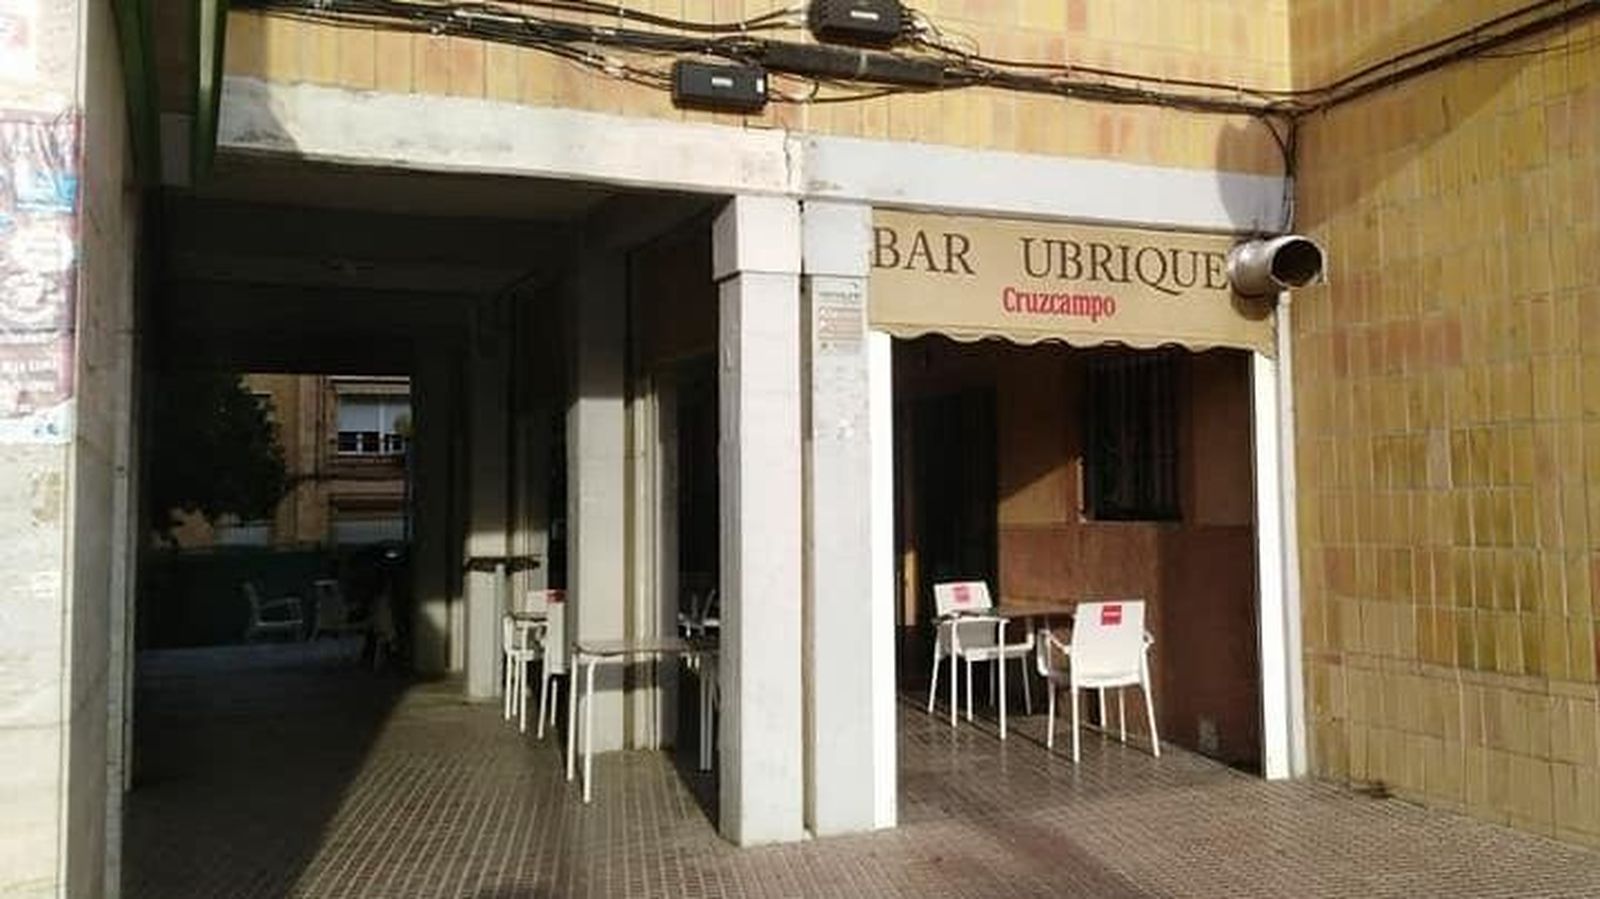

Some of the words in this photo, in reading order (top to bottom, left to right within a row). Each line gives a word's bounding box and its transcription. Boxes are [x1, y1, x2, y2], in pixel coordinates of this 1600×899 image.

[873, 227, 975, 275] BAR
[1021, 237, 1227, 295] UBRIQUE
[1003, 287, 1116, 322] Cruzcampo
